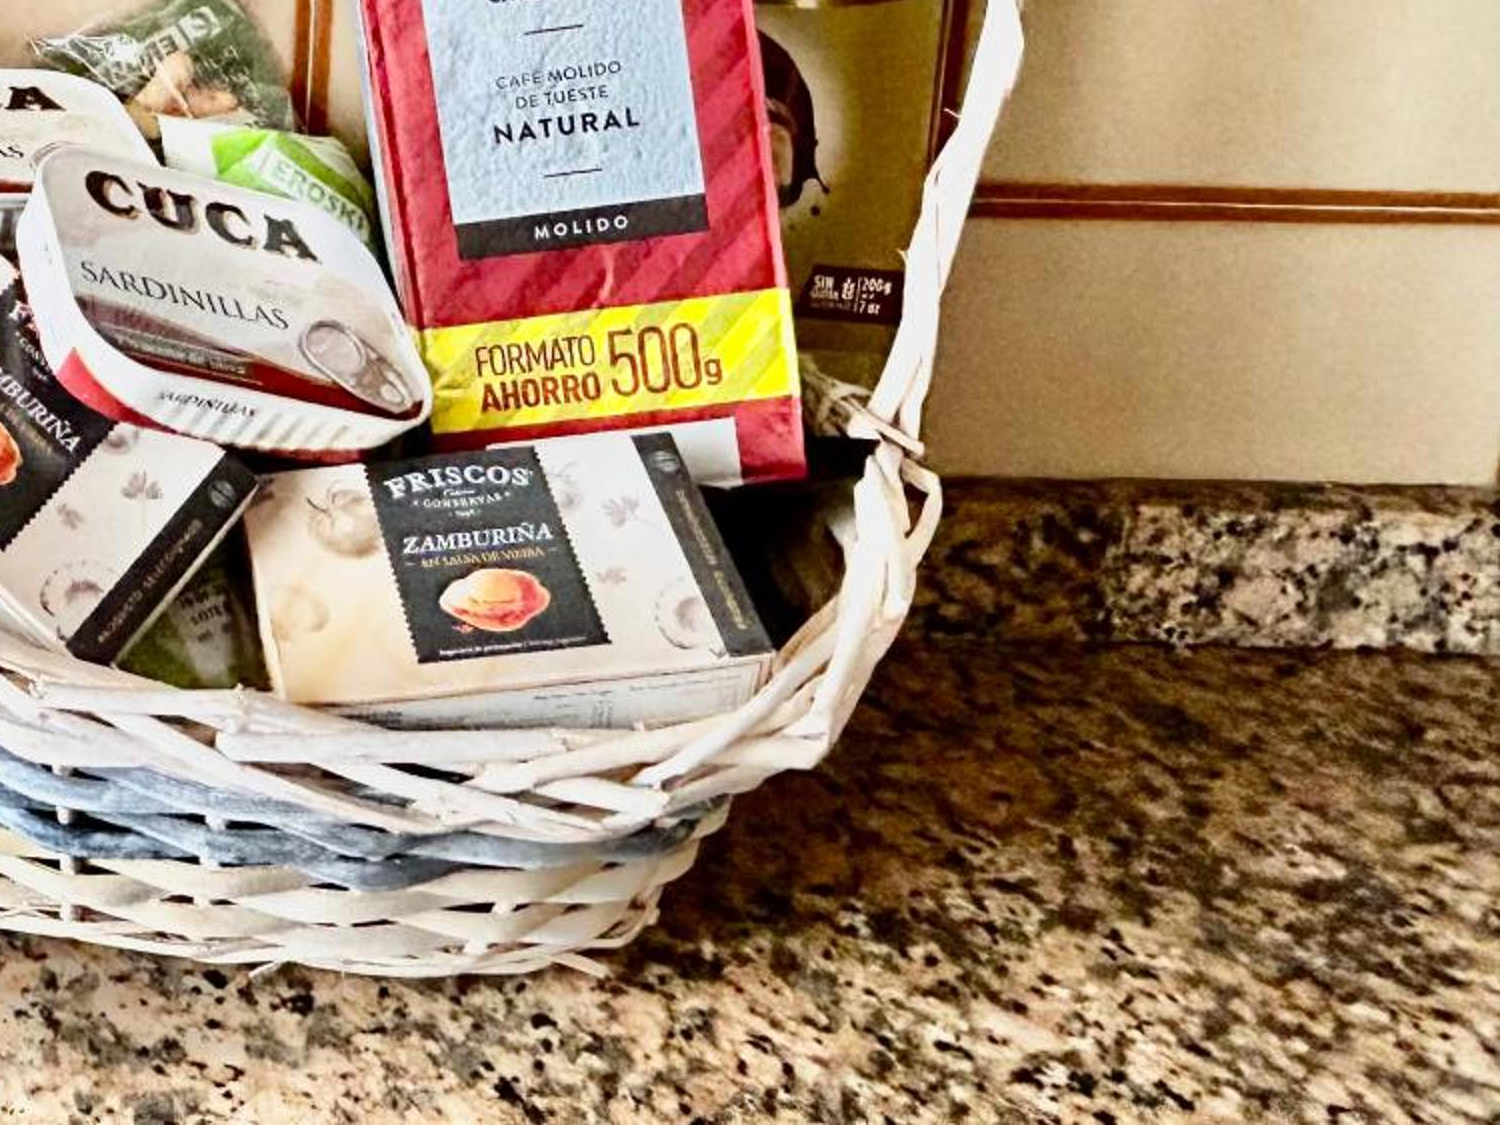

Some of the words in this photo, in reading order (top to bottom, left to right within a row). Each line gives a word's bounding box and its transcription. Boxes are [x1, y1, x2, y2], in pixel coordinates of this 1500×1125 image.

[547, 60, 622, 83] MOLIDO
[515, 94, 540, 110] DE
[543, 84, 609, 106] TUESTE
[493, 106, 640, 144] NATURAL
[85, 169, 323, 267] CUCA
[534, 214, 630, 241] MOLIDO
[80, 259, 291, 332] SARDINILLAS
[475, 334, 596, 377] FORMATO
[480, 371, 602, 414] AHORRO
[382, 464, 532, 500] FRISCOS
[403, 522, 554, 554] ZAMBURIÑA
